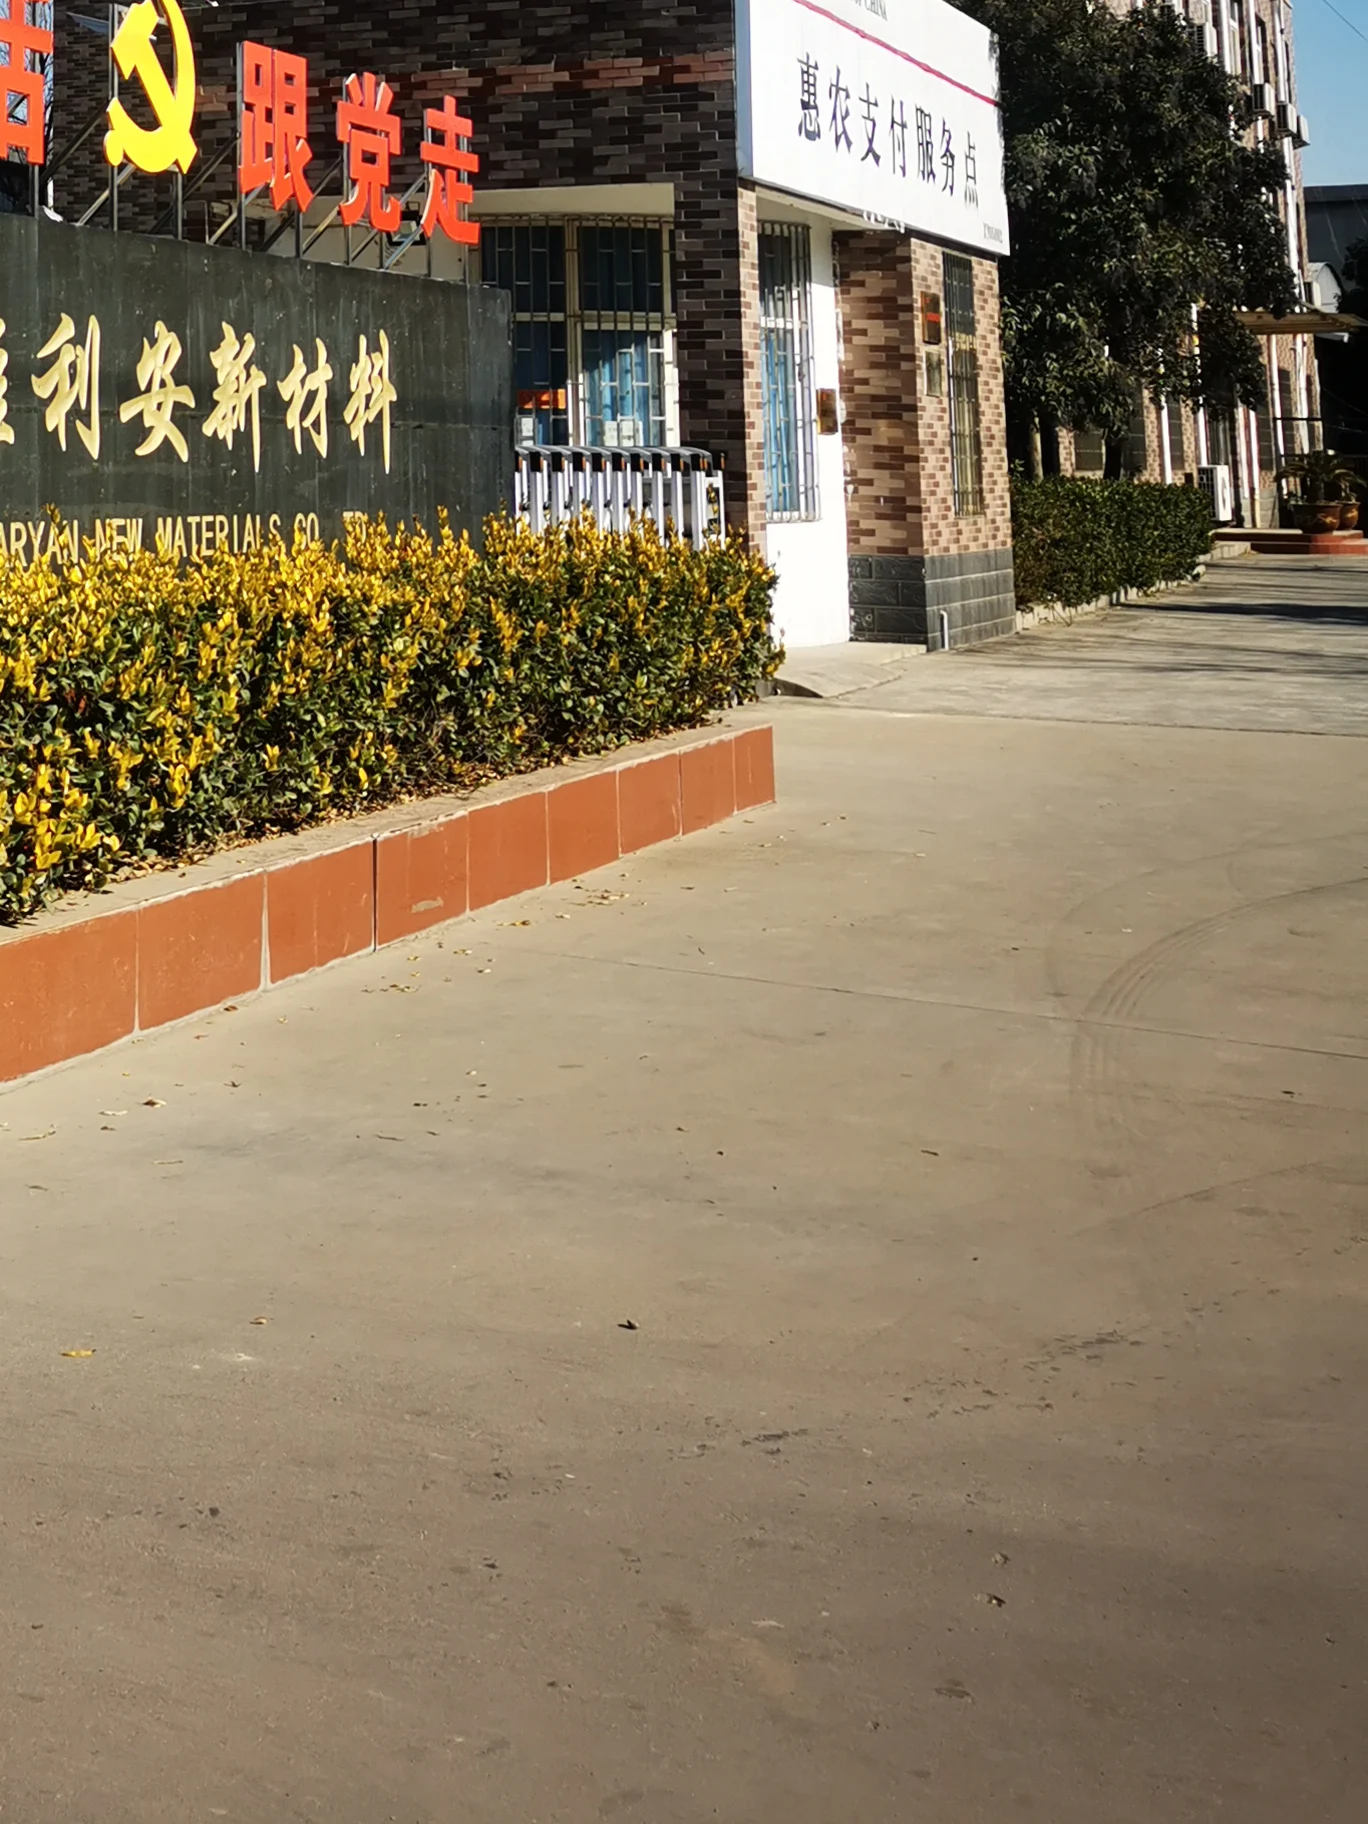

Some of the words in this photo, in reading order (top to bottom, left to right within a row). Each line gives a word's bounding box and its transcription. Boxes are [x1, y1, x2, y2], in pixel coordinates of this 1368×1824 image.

[238, 40, 481, 245] 跟党走
[796, 52, 979, 209] 惠农支付服务点
[94, 518, 144, 562] NEW
